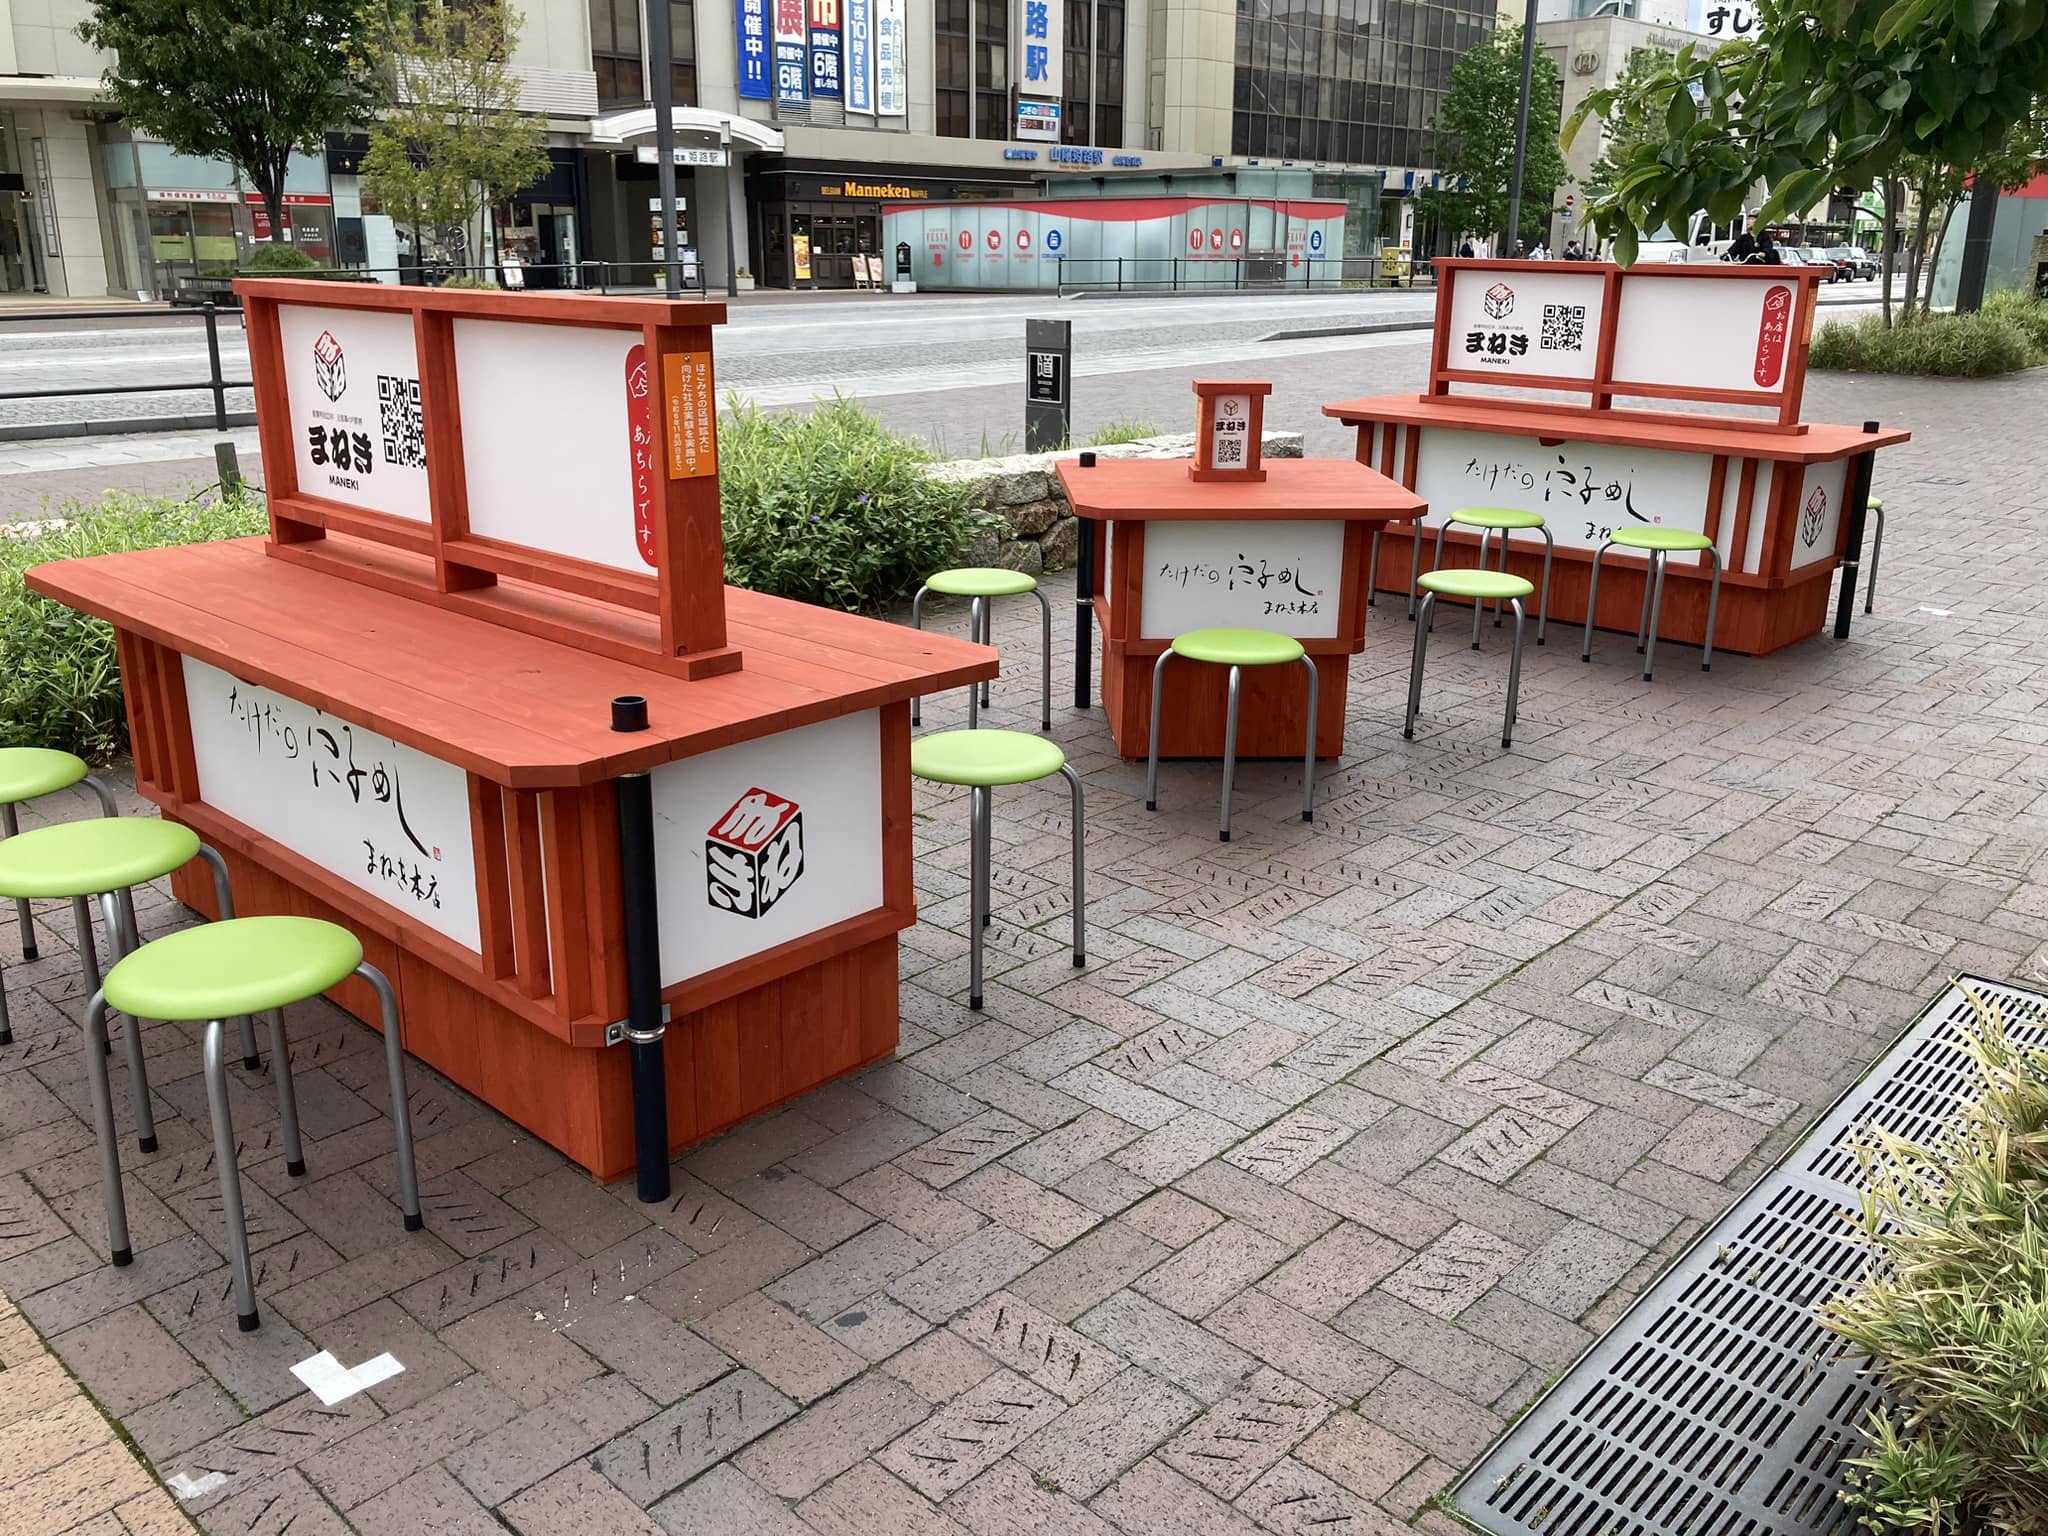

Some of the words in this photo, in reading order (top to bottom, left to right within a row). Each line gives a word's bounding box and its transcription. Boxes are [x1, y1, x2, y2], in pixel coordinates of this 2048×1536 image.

[1025, 1, 1048, 81] 路駅
[778, 65, 803, 90] 6階
[813, 52, 838, 79] 6階
[844, 181, 911, 198] Manneken
[1466, 332, 1529, 356] まねき
[1480, 357, 1510, 365] MANEKI
[1215, 421, 1246, 431] まねき
[308, 424, 373, 475] まねき
[328, 474, 360, 491] MANEKI
